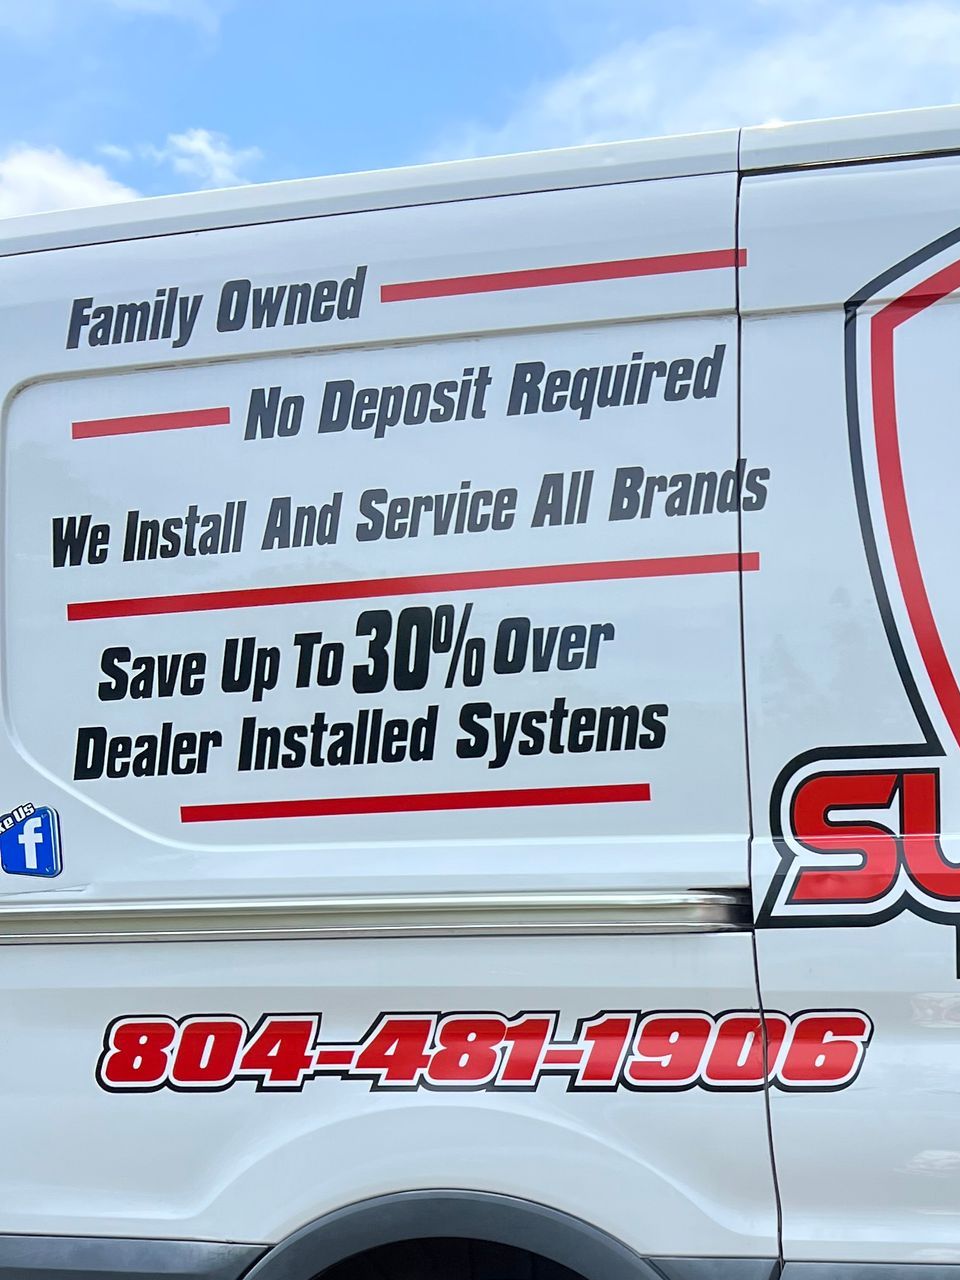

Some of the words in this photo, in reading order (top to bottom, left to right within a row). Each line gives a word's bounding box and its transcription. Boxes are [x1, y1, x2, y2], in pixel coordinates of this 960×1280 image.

[65, 287, 203, 350] Family
[216, 265, 368, 334] Owned
[244, 386, 302, 441] No
[317, 366, 492, 439] Deposit
[505, 344, 726, 421] Required
[52, 514, 110, 568] We
[122, 500, 247, 562] Install
[261, 491, 343, 550] And
[355, 480, 518, 542] Service
[530, 469, 594, 528] All
[608, 457, 771, 522] Brands
[98, 645, 206, 701] Save
[220, 635, 281, 702] Up
[293, 630, 345, 688] To
[351, 602, 486, 695] 30%
[493, 616, 616, 676] Over
[73, 722, 224, 781] Dealer
[237, 704, 439, 773] Installed
[454, 696, 670, 769] Systems
[12, 803, 35, 822] Us
[103, 1015, 869, 1088] 804-481-1906
